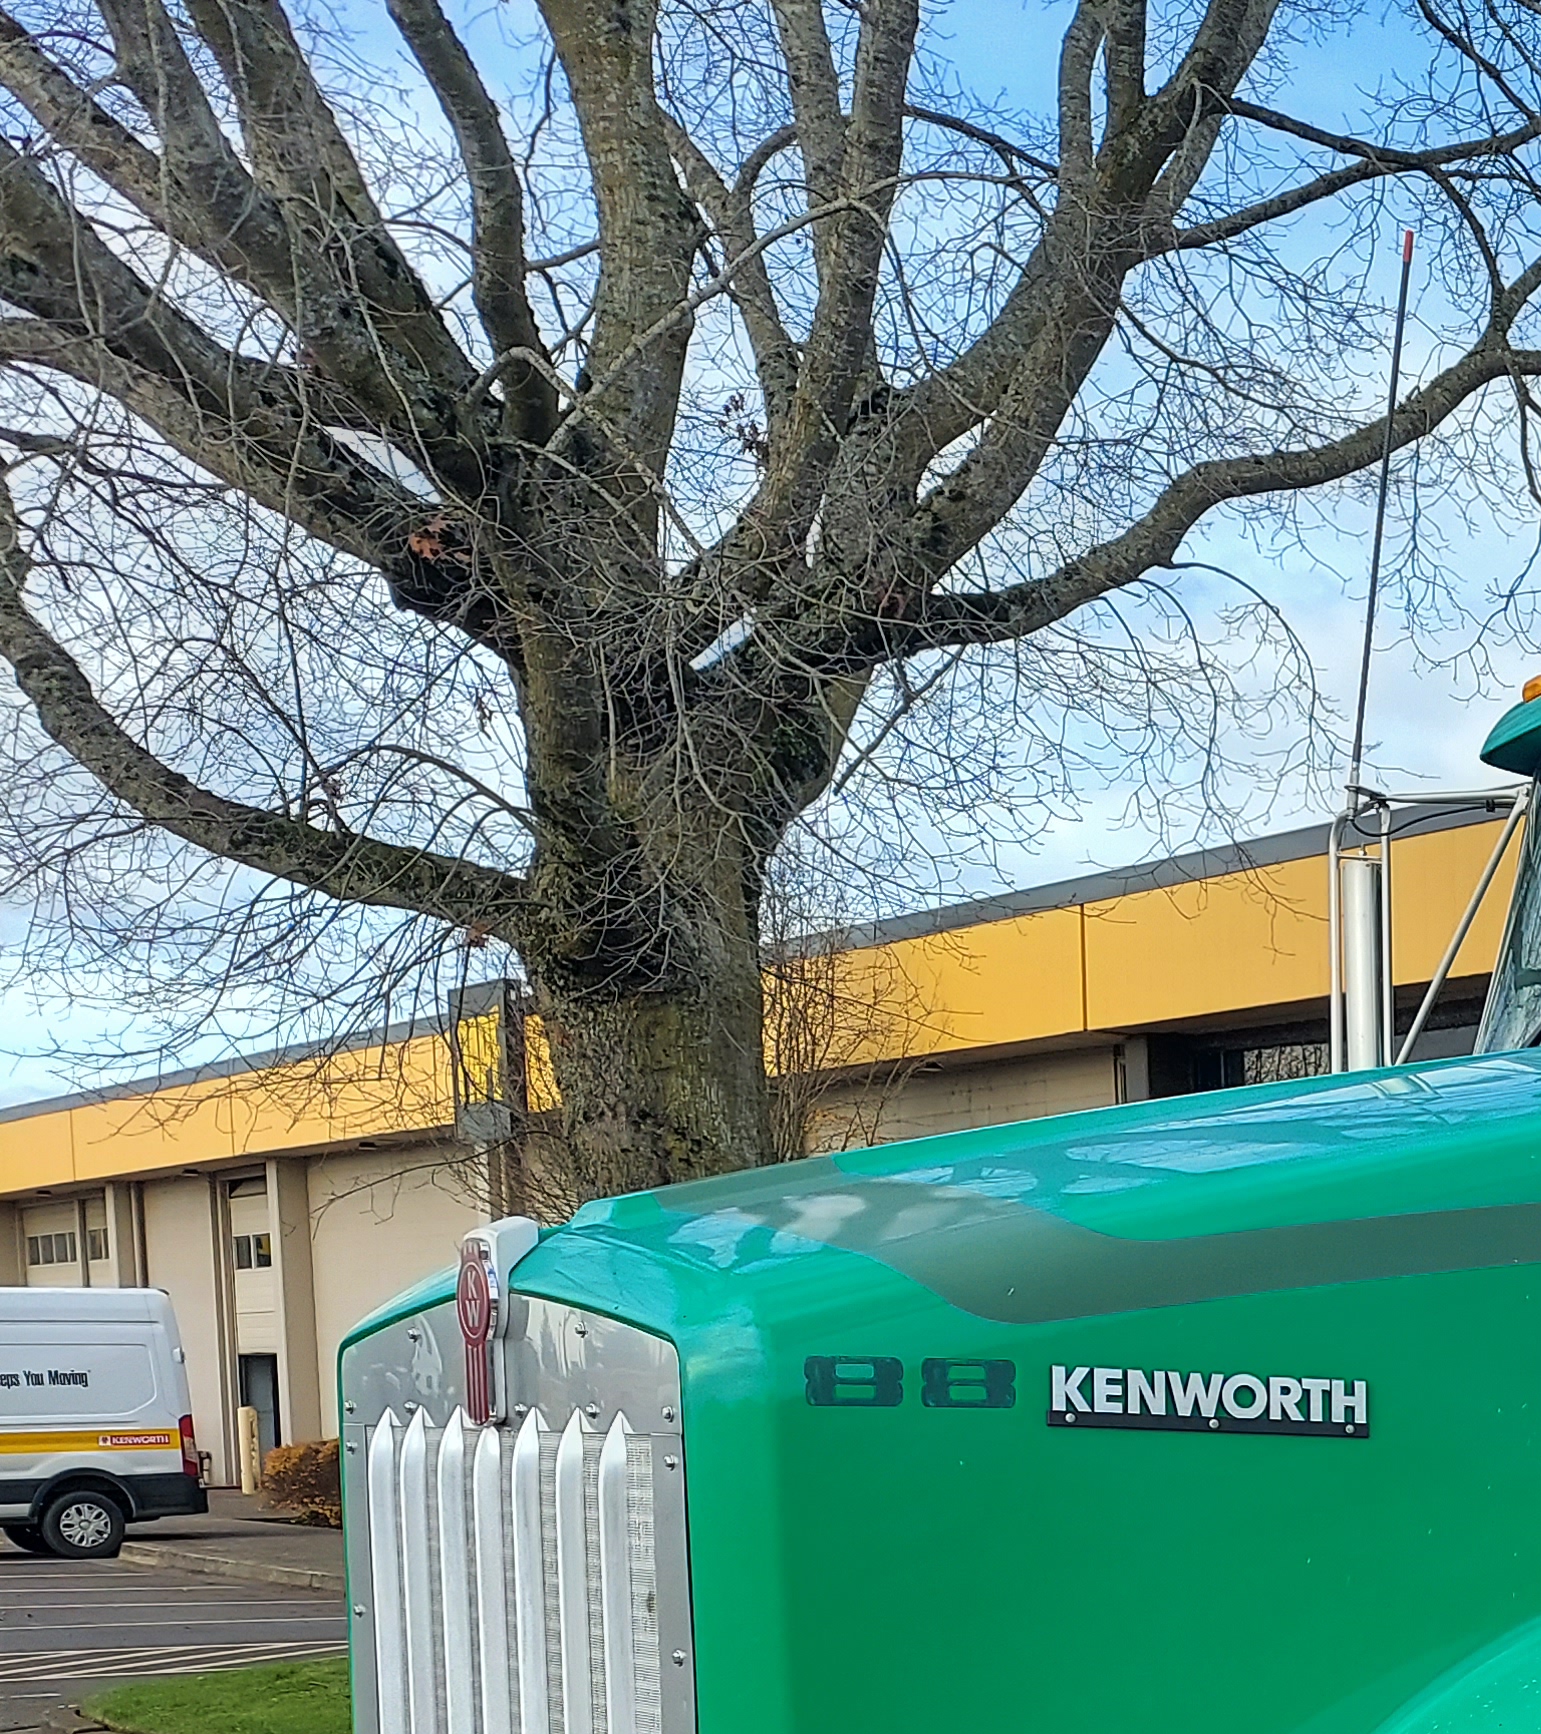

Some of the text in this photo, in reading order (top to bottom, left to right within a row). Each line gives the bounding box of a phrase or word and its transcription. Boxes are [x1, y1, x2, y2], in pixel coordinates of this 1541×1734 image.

[467, 1271, 477, 1299] K
[465, 1300, 481, 1328] W
[22, 1370, 45, 1387] You
[47, 1369, 89, 1388] Moving
[1050, 1364, 1368, 1425] KENWORTH
[112, 1434, 169, 1444] KENWORTH
